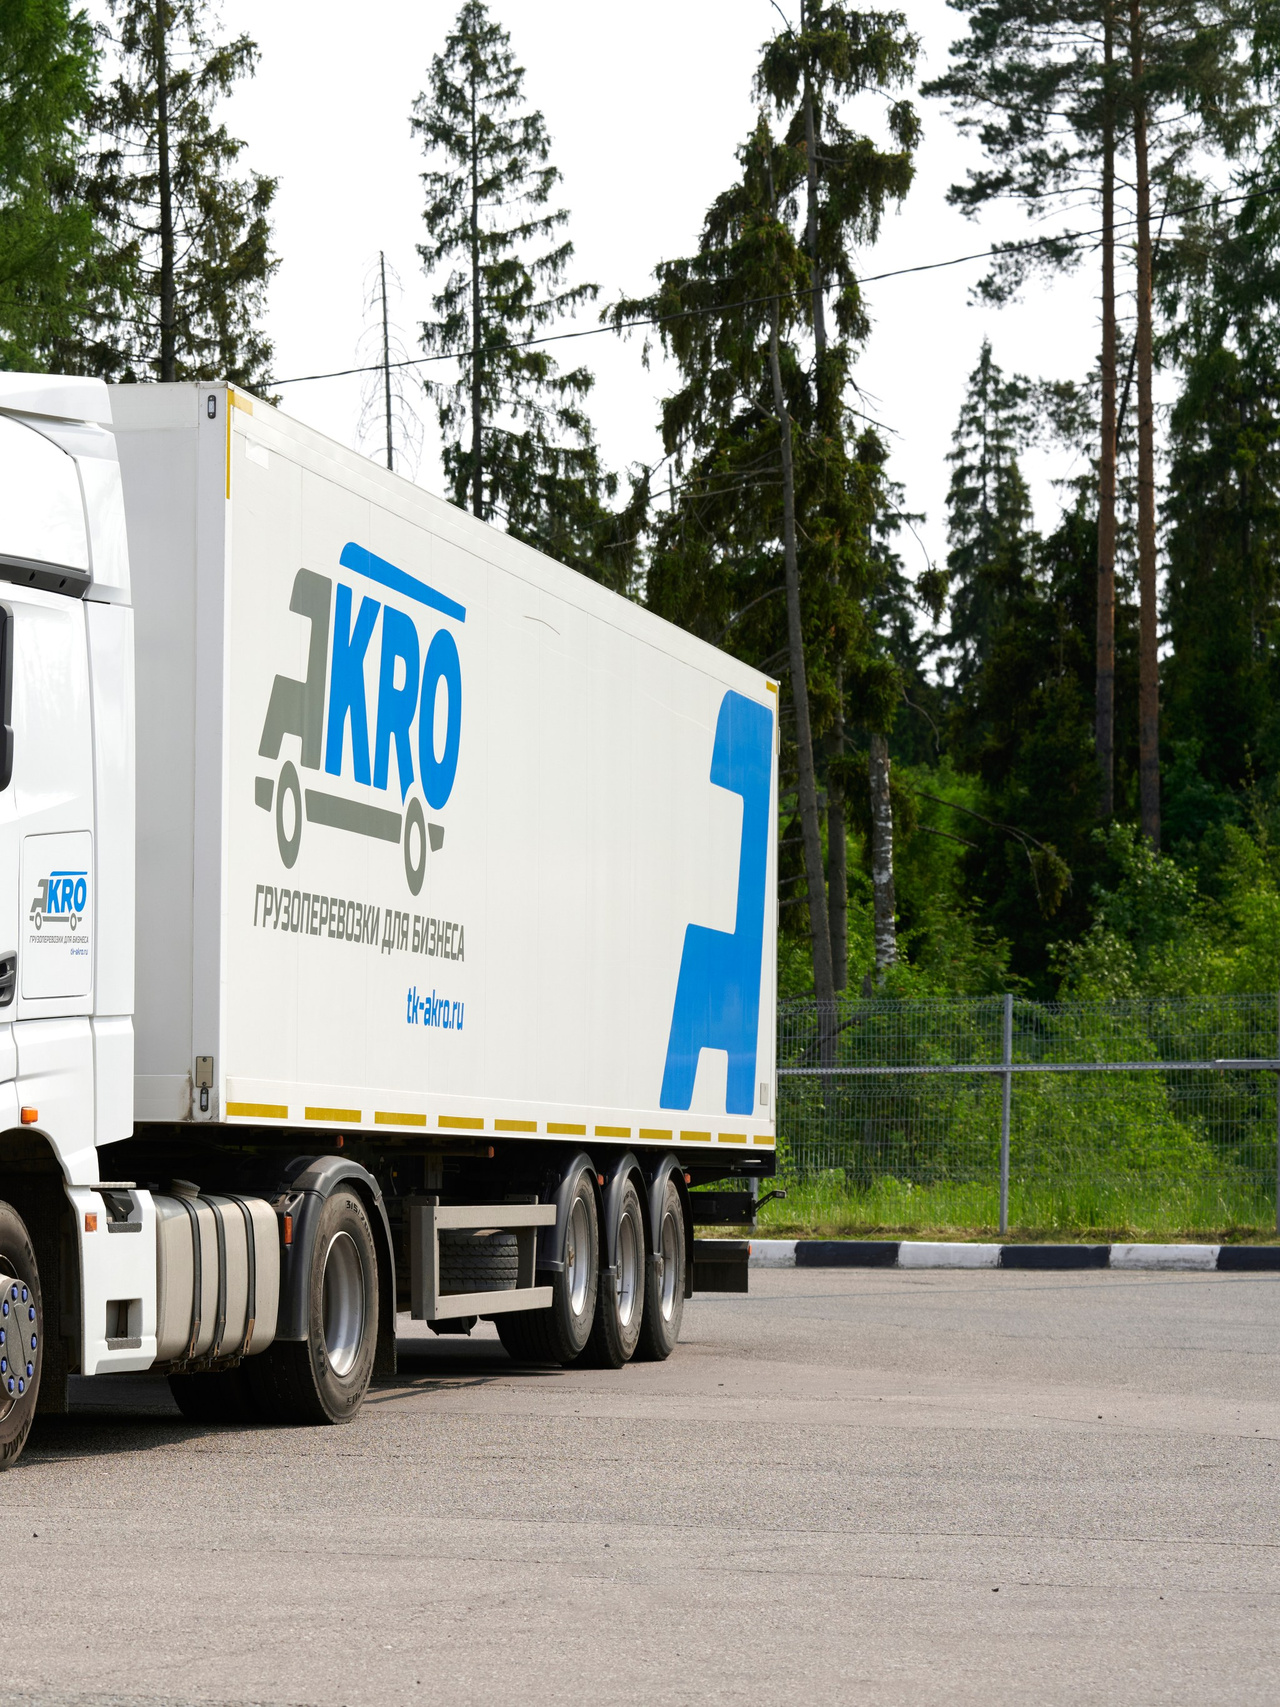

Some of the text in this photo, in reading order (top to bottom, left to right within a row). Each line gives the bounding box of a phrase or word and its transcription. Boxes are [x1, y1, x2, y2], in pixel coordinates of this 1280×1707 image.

[253, 883, 465, 962] ГРУЗОПЕРЕВОЗКИ ДЛЯ БИЗНЕСА
[406, 986, 465, 1031] tk-akro.ru
